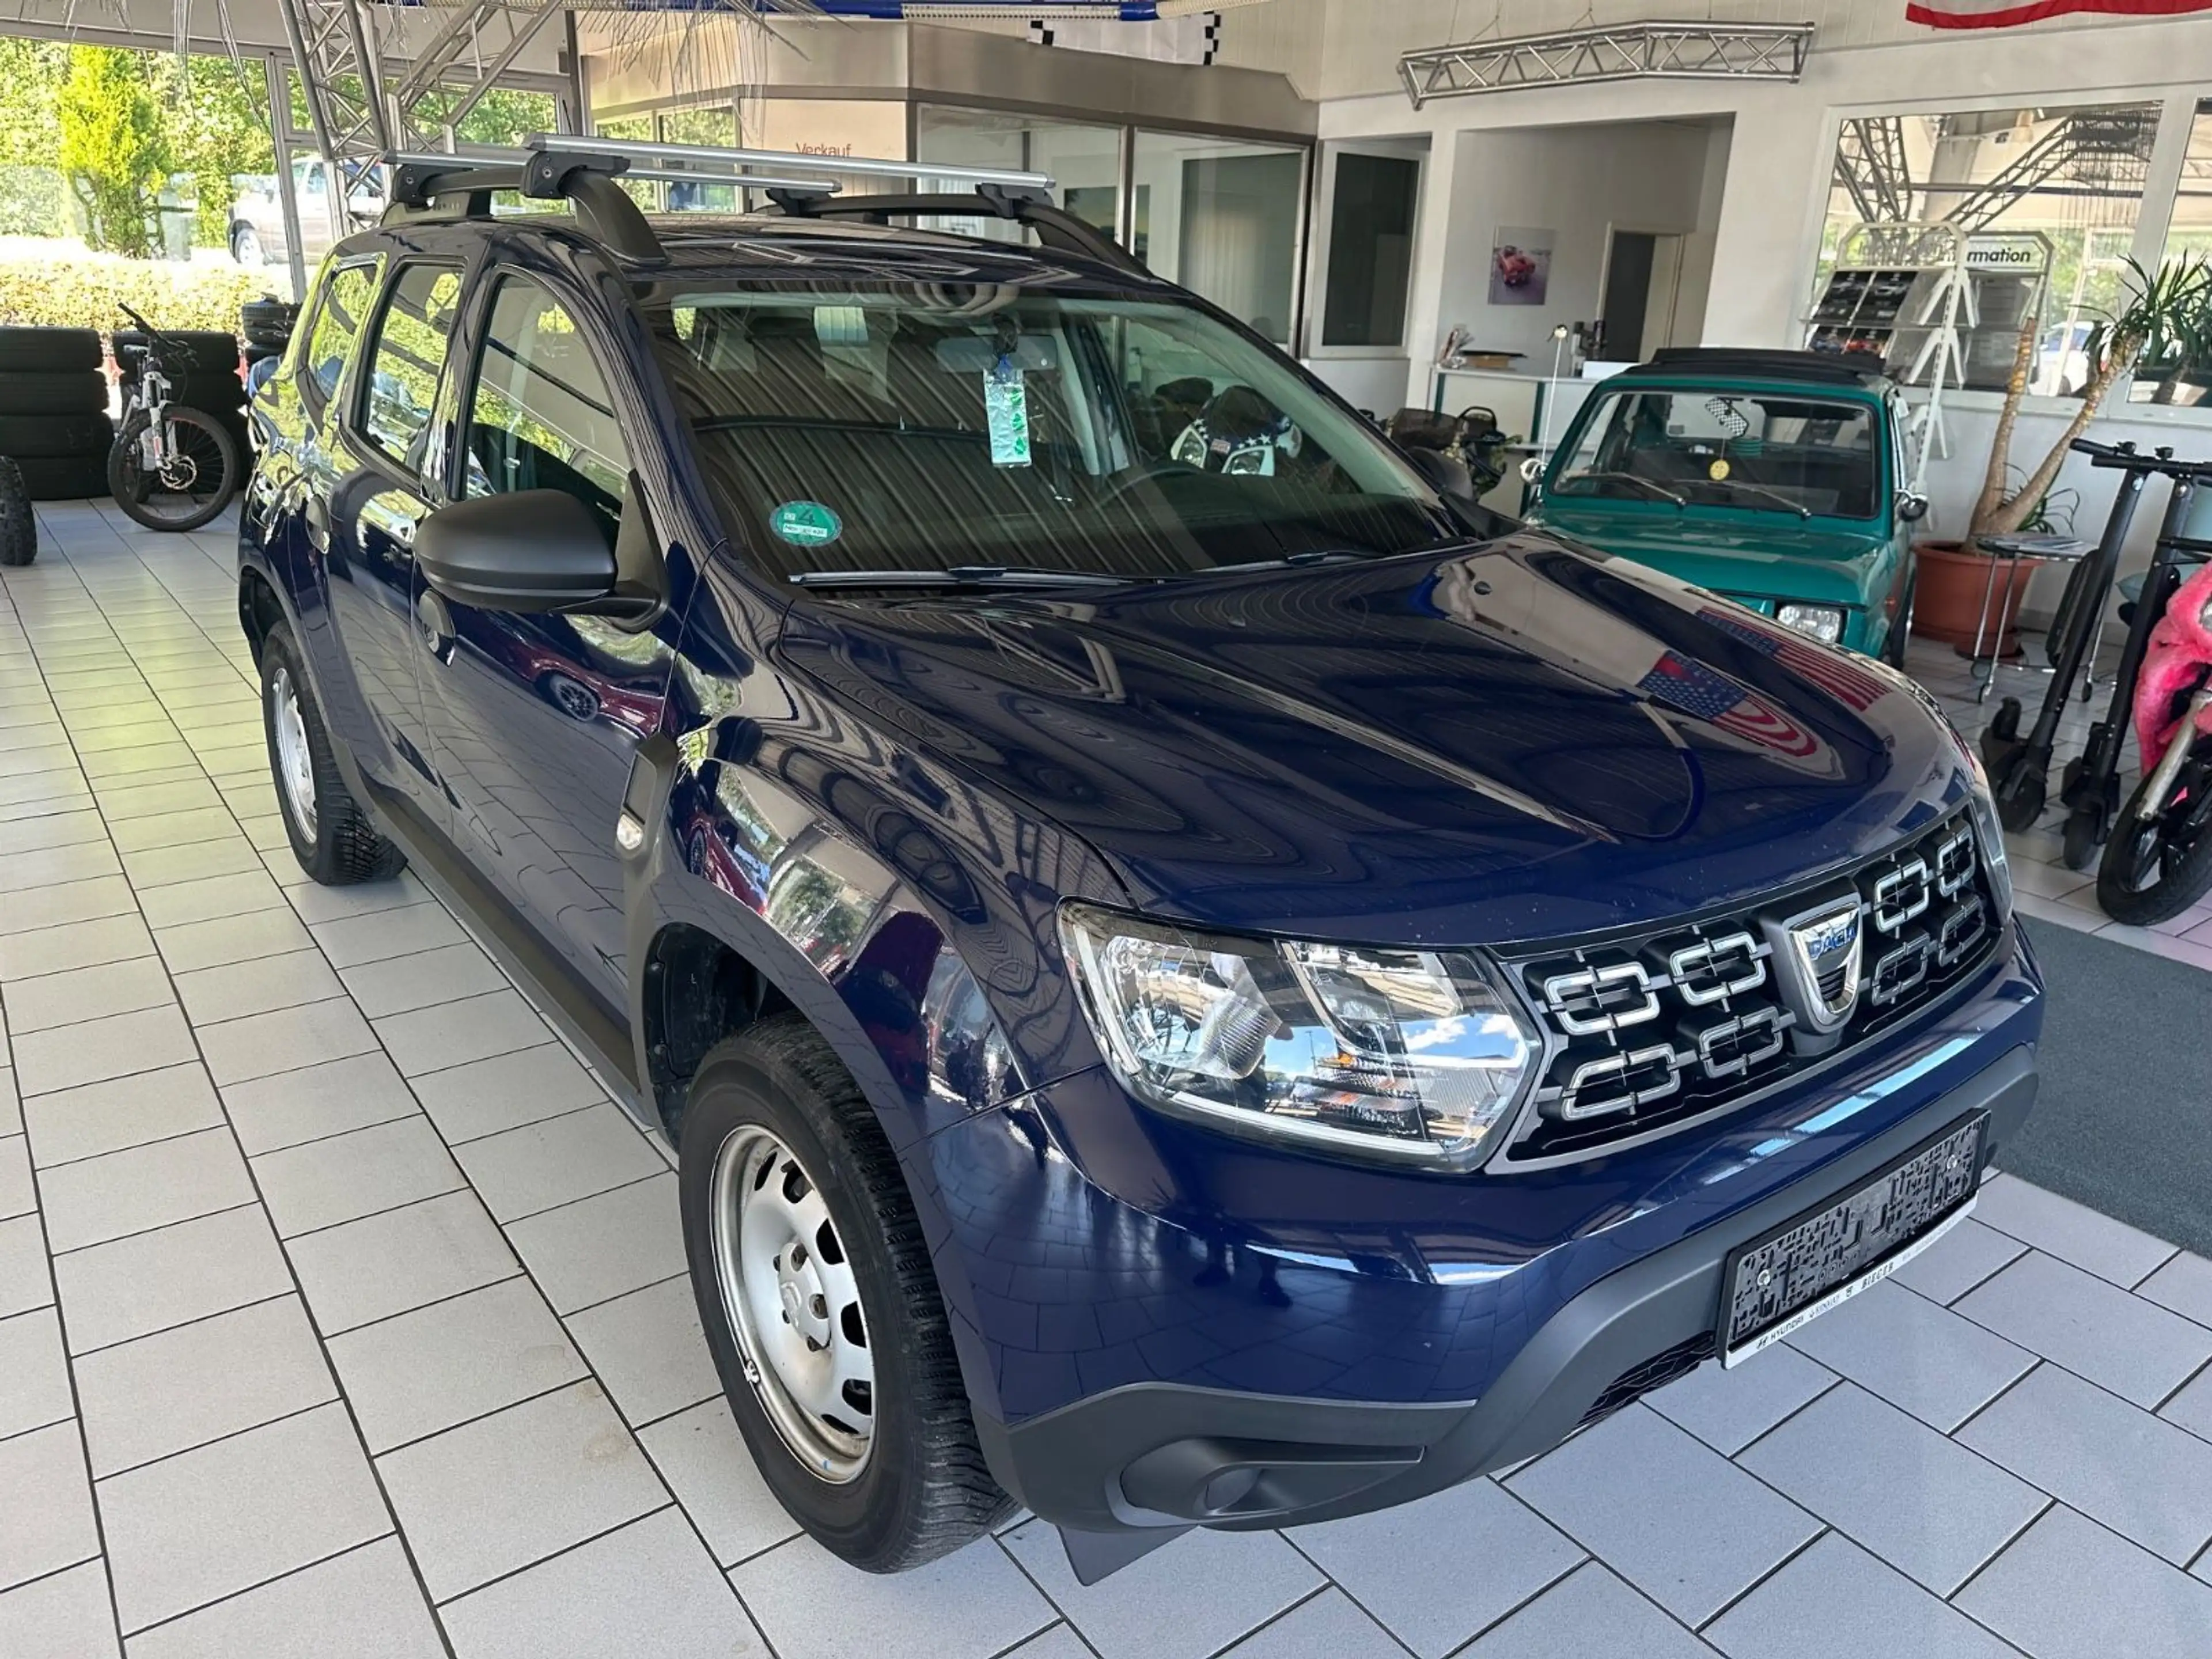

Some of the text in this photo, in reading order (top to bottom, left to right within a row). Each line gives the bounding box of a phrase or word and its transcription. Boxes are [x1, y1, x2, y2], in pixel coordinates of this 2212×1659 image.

[796, 142, 851, 157] Verkauf
[1967, 247, 2031, 263] rmation
[798, 507, 815, 525] 4
